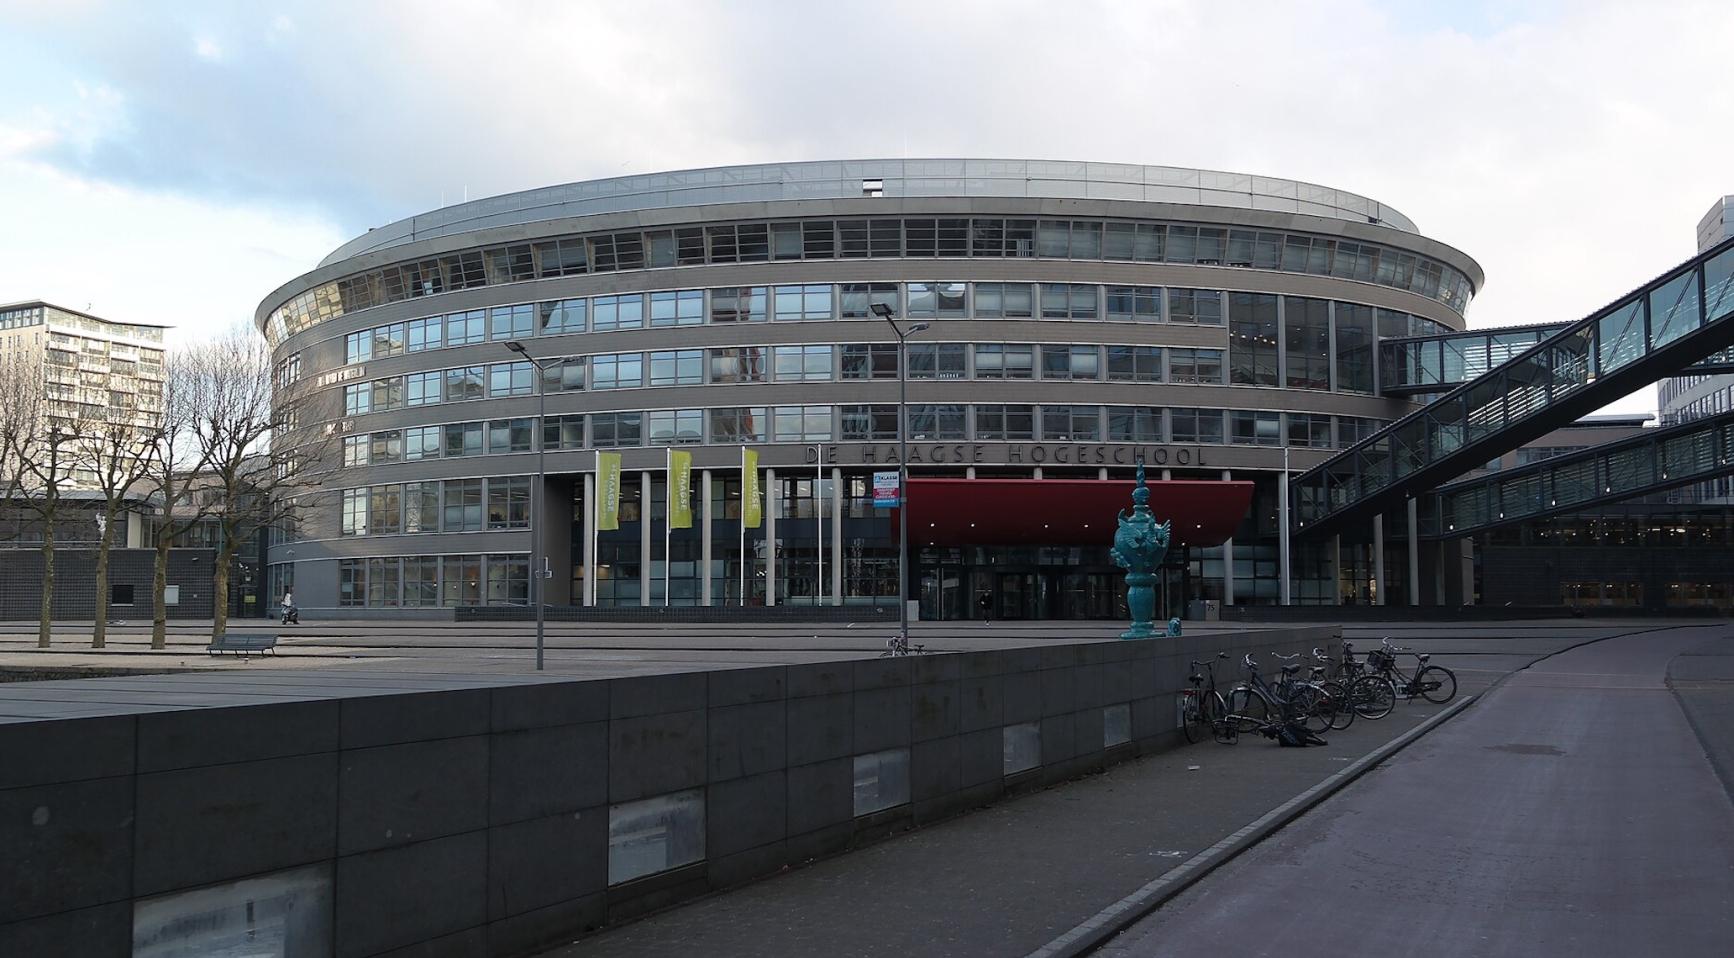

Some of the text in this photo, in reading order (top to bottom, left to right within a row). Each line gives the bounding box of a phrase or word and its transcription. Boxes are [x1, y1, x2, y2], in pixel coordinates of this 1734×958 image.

[806, 445, 1207, 465] DE HAAGSE HOGESCHOOL
[680, 471, 688, 511] HAAGSE
